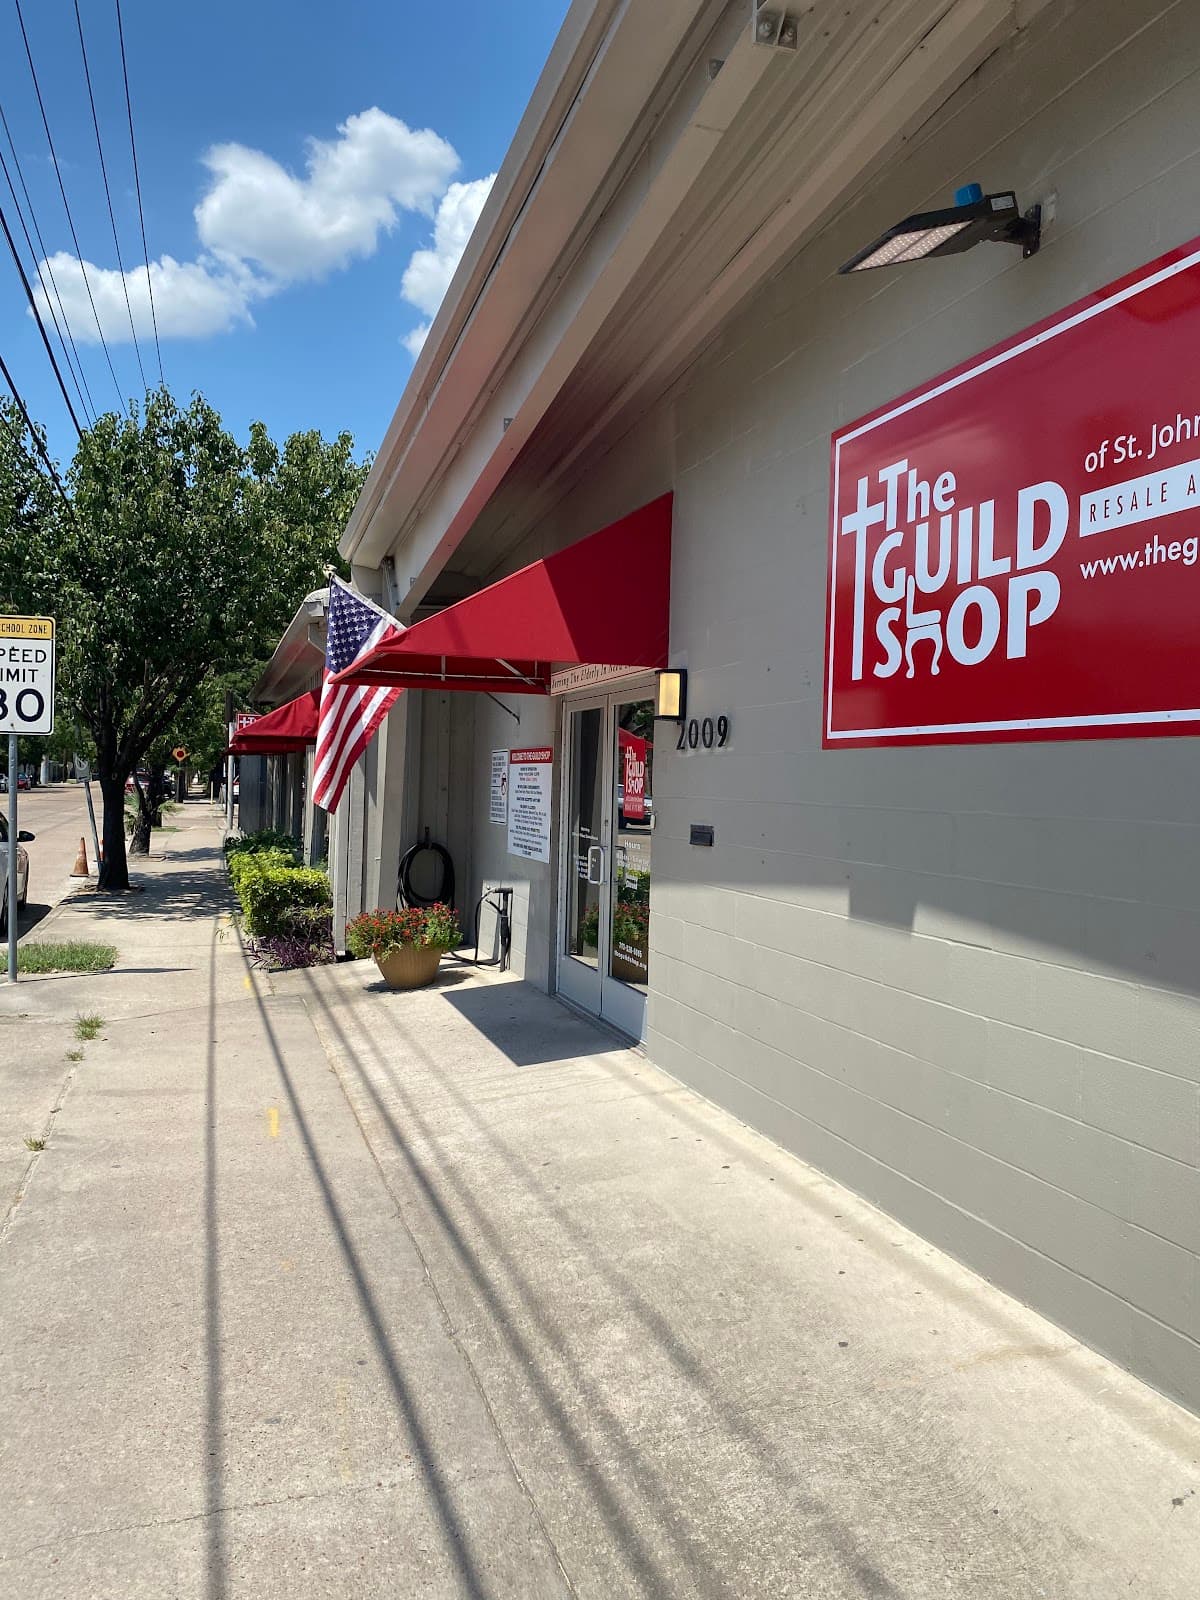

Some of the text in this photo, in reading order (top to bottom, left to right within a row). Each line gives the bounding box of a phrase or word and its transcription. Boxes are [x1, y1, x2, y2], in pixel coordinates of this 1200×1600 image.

[1084, 440, 1109, 473] of
[1113, 434, 1143, 464] St.
[878, 458, 957, 532] The
[1089, 482, 1168, 523] RESALE
[872, 480, 1070, 604] GUILD
[0, 623, 48, 635] CHOOL ZONE
[873, 570, 1061, 679] SHOP
[0, 648, 47, 664] PEED
[0, 667, 39, 683] IMIT
[676, 715, 729, 750] 2009
